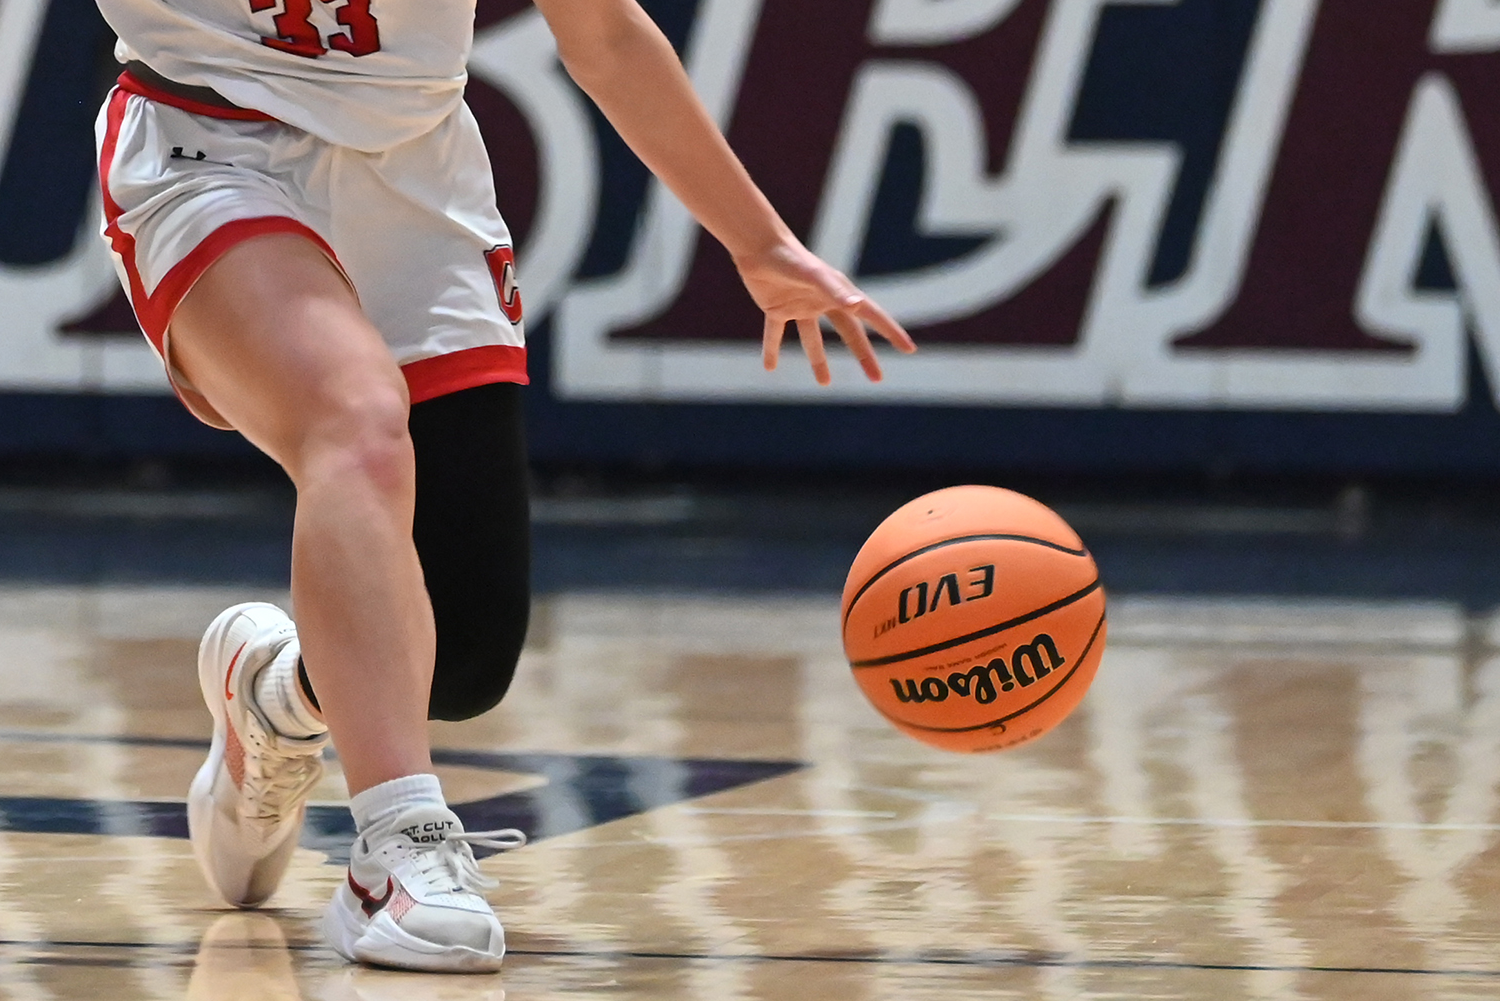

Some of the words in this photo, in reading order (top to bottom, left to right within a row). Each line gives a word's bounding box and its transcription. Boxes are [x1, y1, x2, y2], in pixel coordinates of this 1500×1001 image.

[898, 564, 996, 625] EVO
[889, 633, 1067, 706] Wilson
[423, 821, 454, 832] CUT
